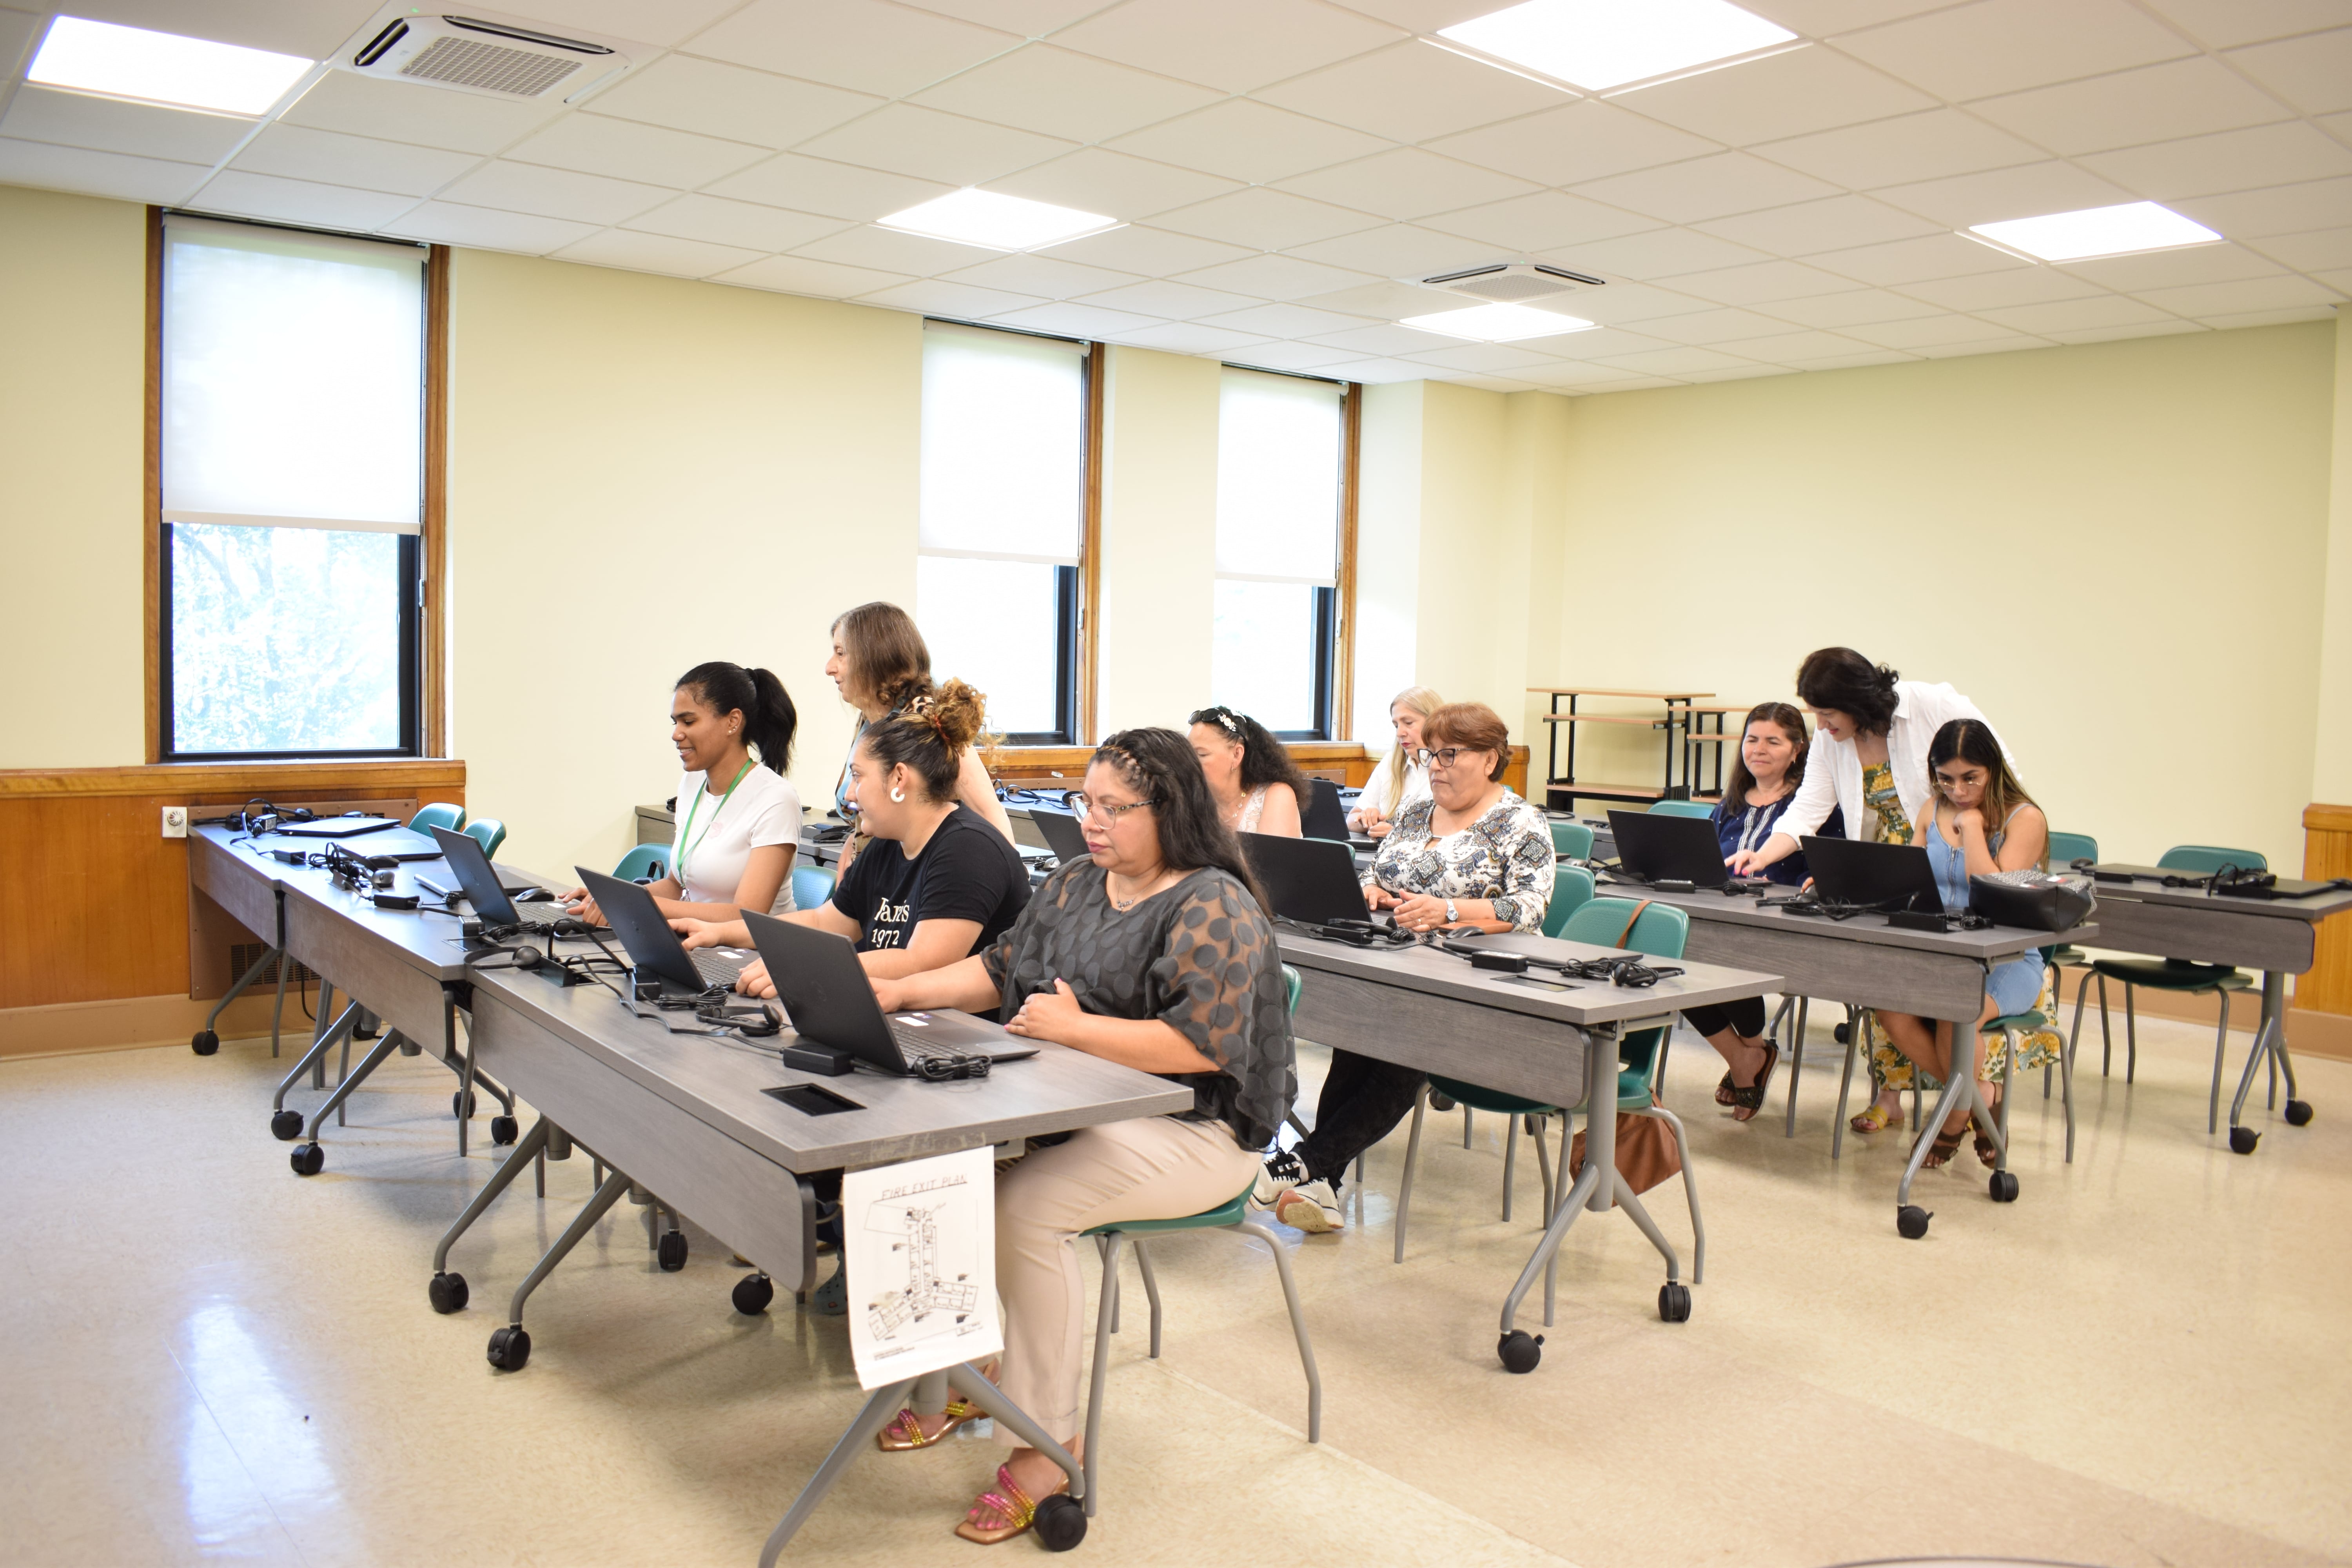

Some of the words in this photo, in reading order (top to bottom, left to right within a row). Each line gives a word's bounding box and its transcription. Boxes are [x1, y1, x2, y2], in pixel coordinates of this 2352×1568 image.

[871, 928, 900, 949] 1972
[882, 1185, 908, 1200] FIRE
[913, 1179, 936, 1194] EXIT
[942, 1173, 967, 1188] PLAN
